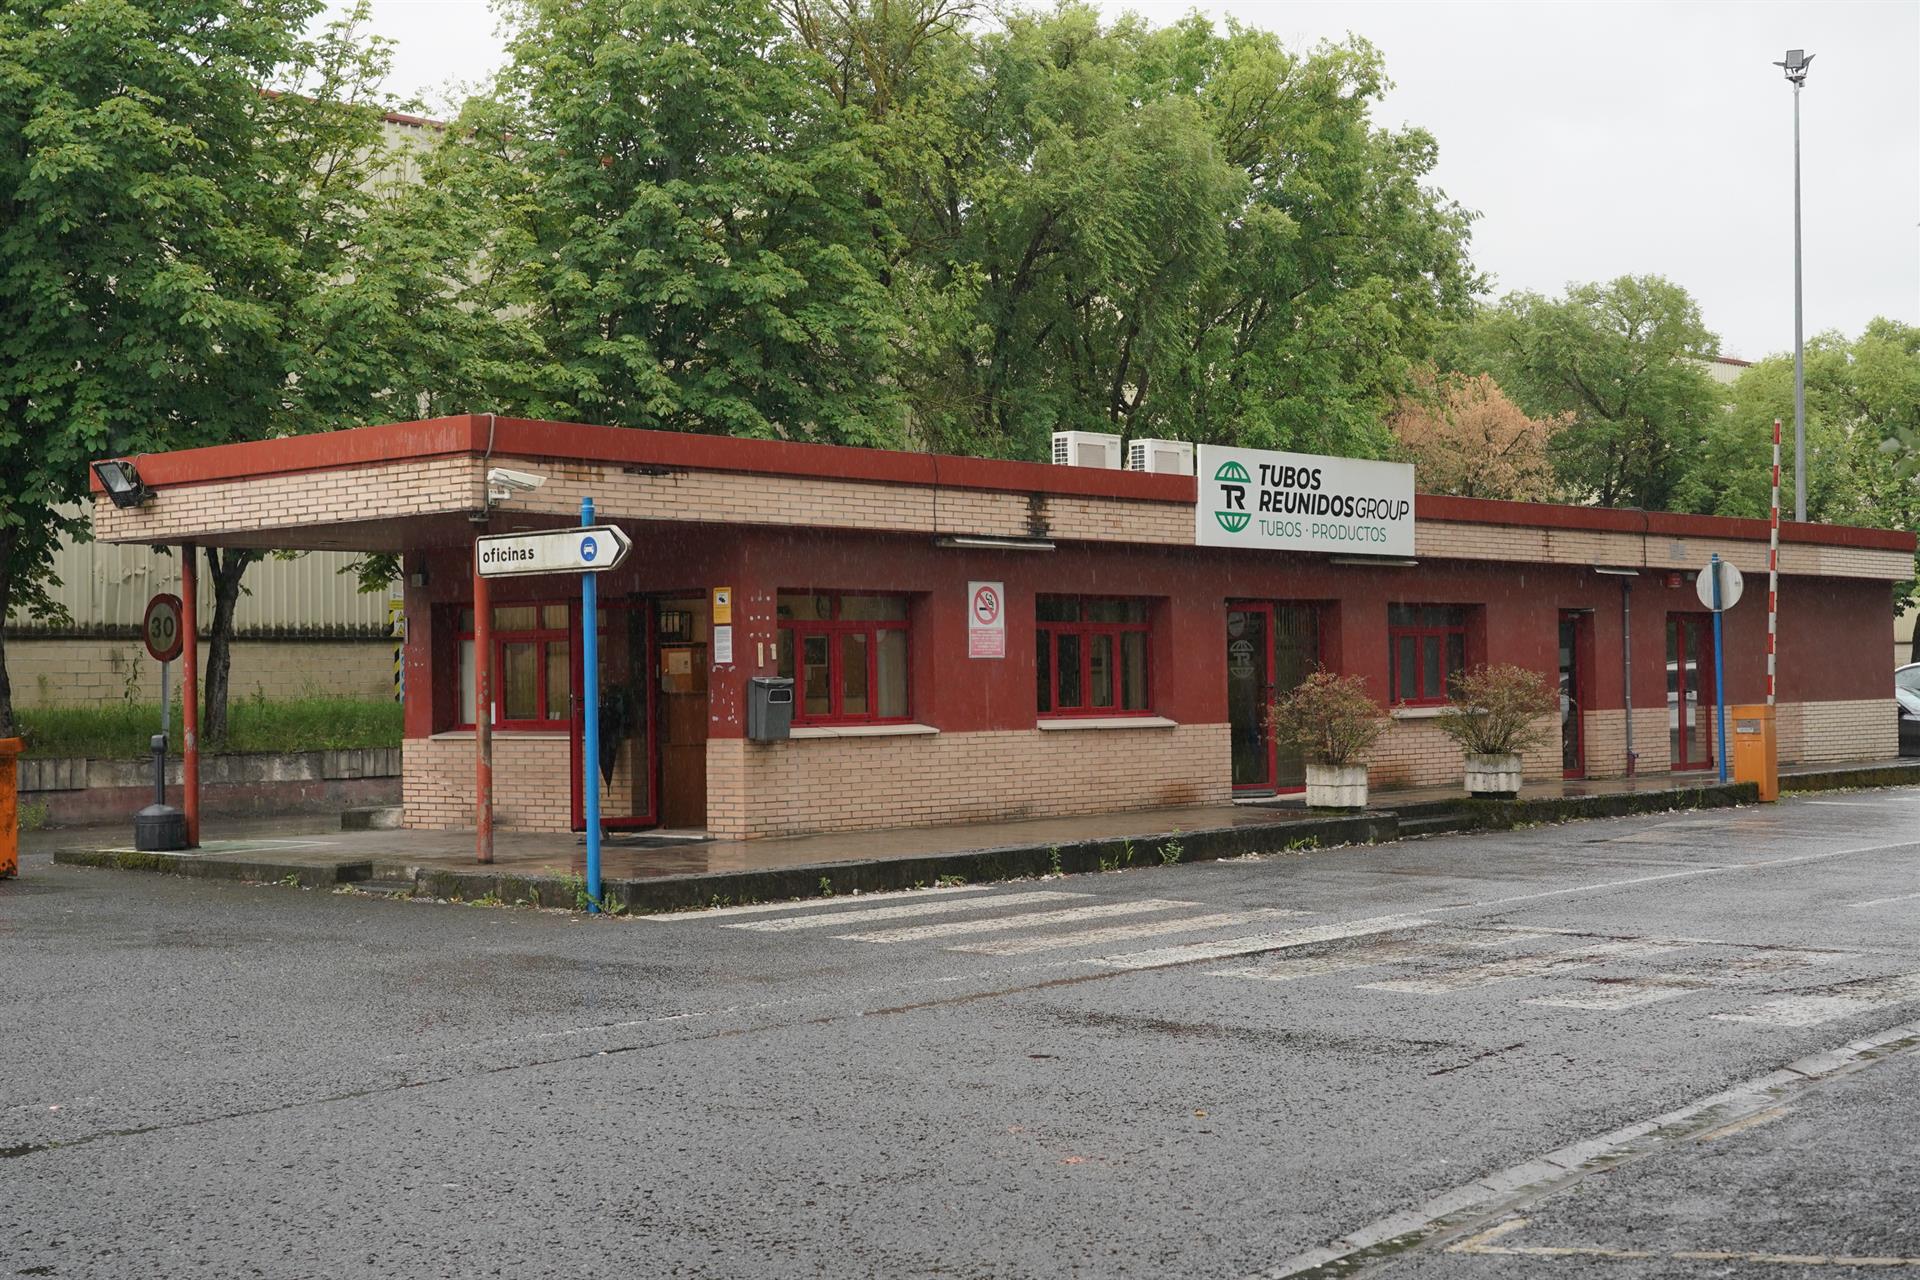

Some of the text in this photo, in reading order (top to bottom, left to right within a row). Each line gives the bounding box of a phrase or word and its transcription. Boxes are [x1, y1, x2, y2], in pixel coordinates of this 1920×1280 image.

[1259, 464, 1321, 490] TUBOS
[1220, 484, 1245, 510] TR
[1259, 520, 1387, 542] TUBOS PRODUCTOS
[483, 546, 534, 563] oficinas
[152, 616, 174, 639] 30
[1233, 652, 1250, 666] TR
